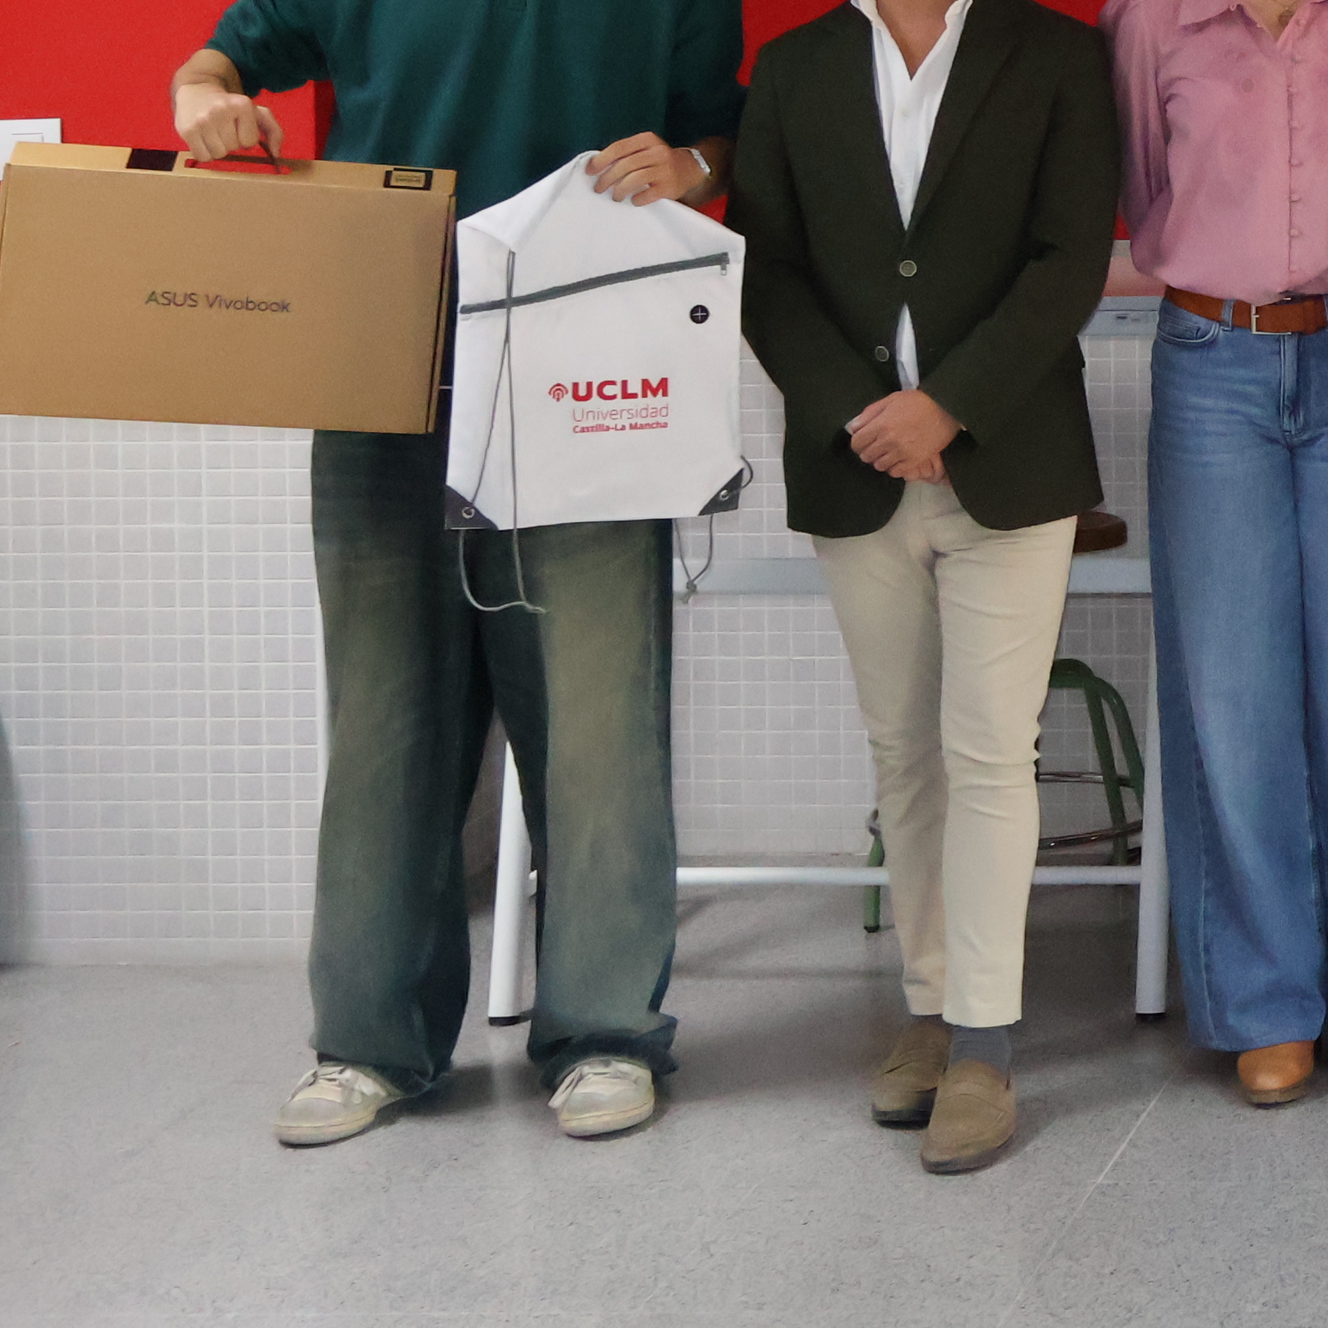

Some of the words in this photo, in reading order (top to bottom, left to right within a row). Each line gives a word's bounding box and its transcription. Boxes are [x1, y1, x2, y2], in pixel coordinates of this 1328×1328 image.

[145, 290, 198, 308] ASUS
[205, 293, 292, 313] Vivobook
[571, 377, 669, 402] UCLM
[572, 403, 669, 422] Universidad
[572, 423, 626, 433] Castilla-La
[629, 421, 669, 431] Mancha
